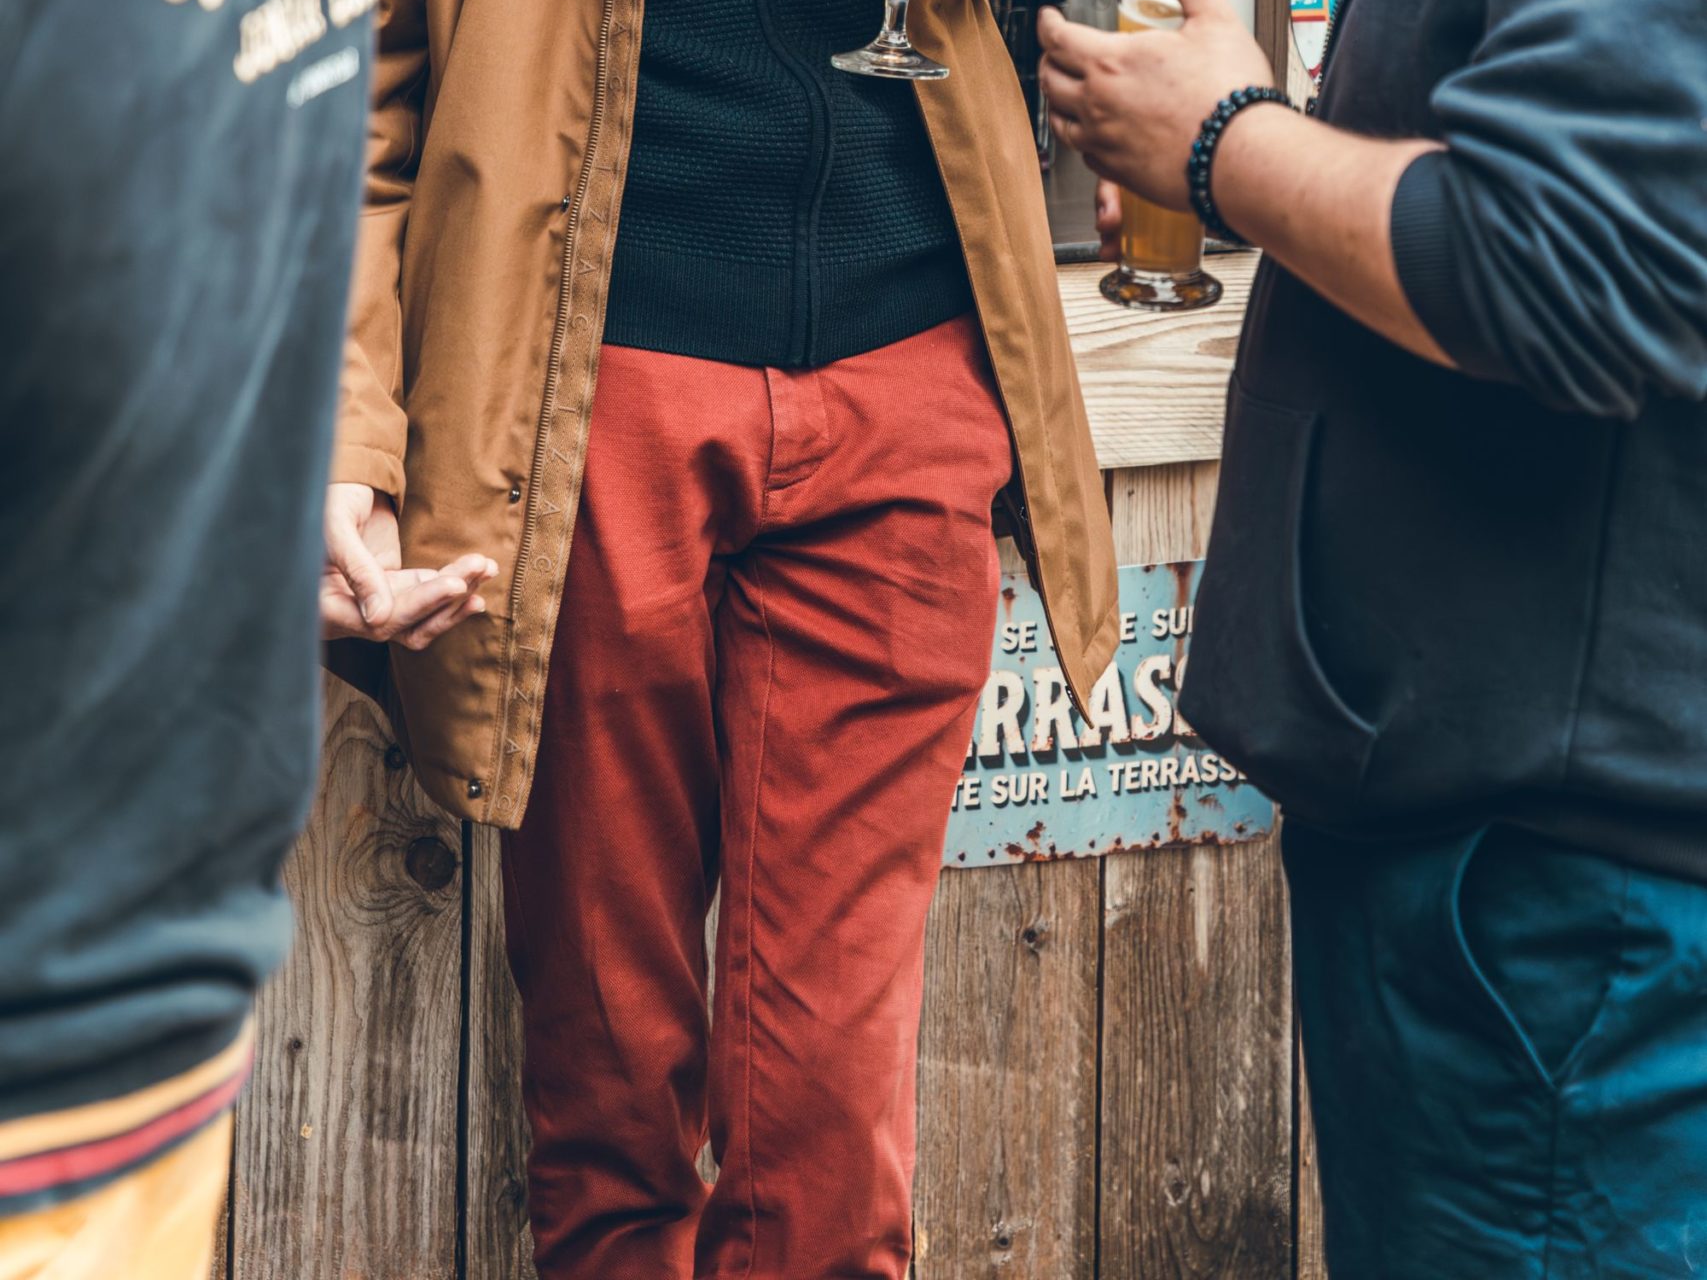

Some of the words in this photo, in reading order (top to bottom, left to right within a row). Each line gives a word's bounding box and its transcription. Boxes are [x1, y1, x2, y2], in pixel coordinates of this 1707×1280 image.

[1000, 621, 1037, 652] SE
[990, 772, 1048, 805] SUR
[1060, 767, 1097, 799] LA
